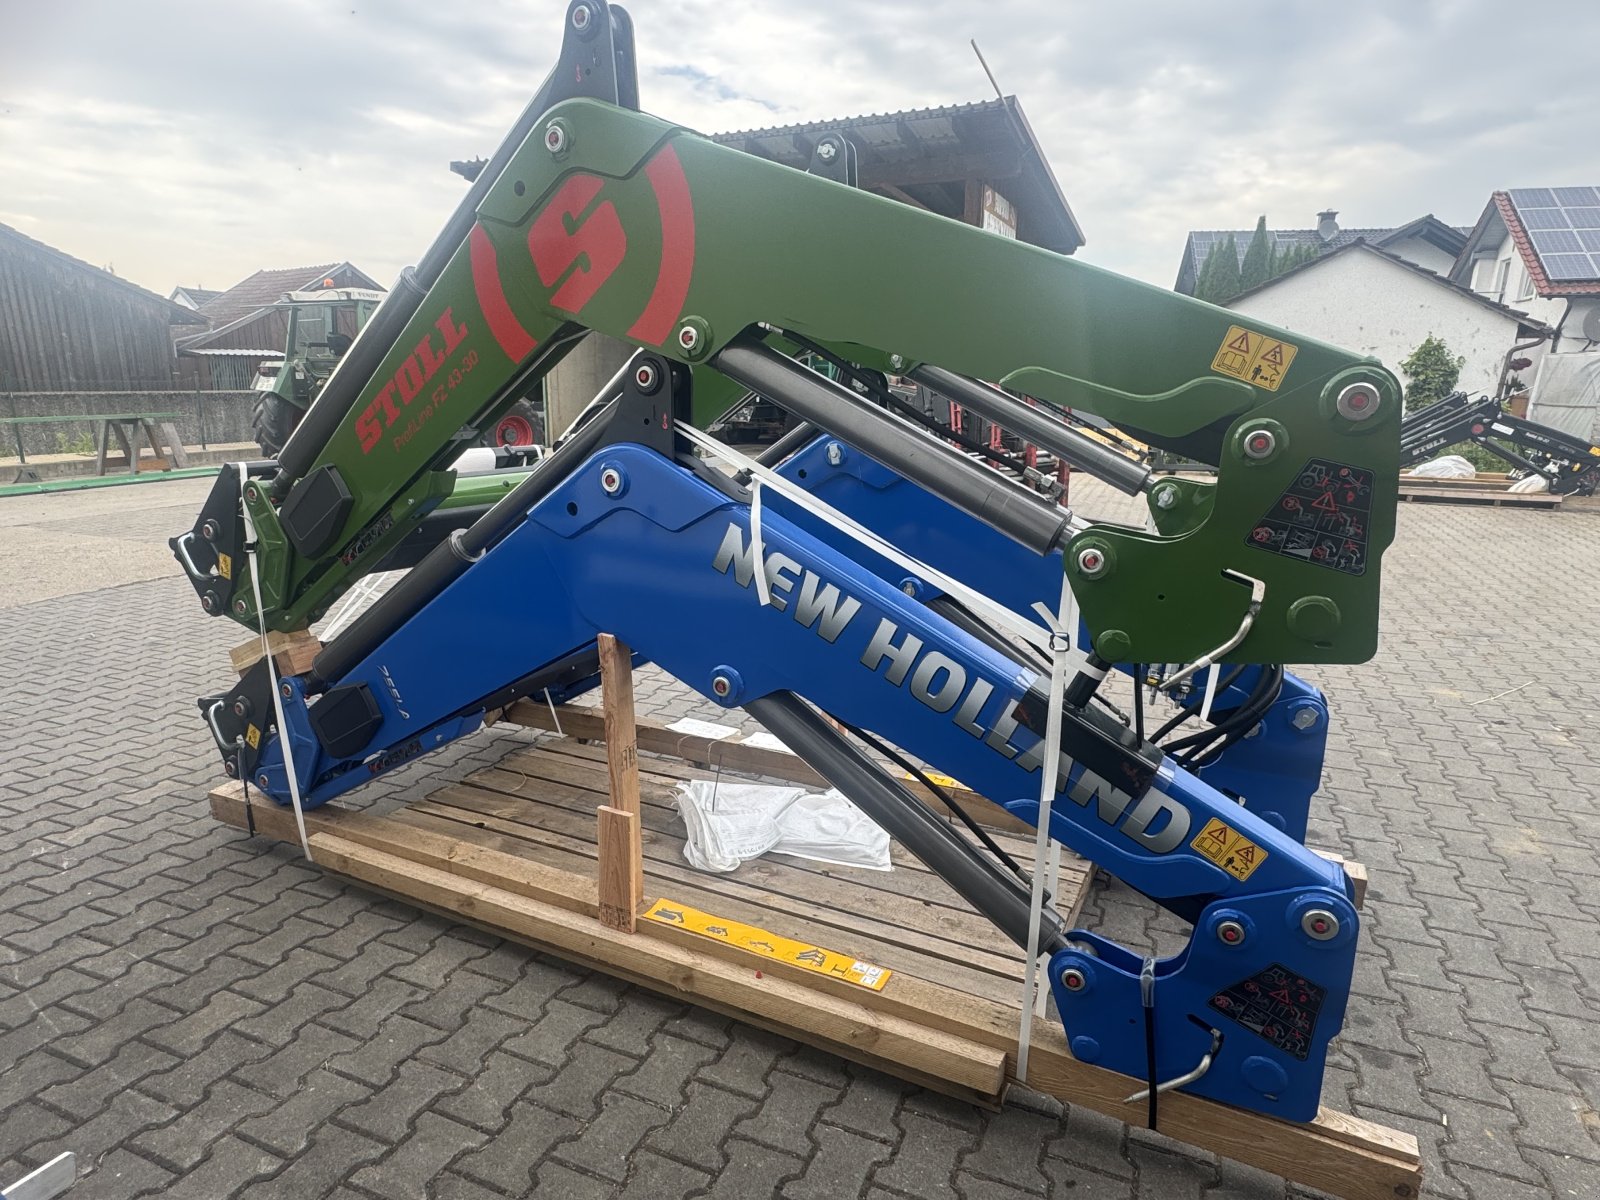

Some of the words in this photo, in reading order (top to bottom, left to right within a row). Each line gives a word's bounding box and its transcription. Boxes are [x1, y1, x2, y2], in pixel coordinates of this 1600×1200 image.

[354, 306, 469, 455] STOLL
[447, 350, 479, 391] 43-30
[712, 522, 862, 645] NEW
